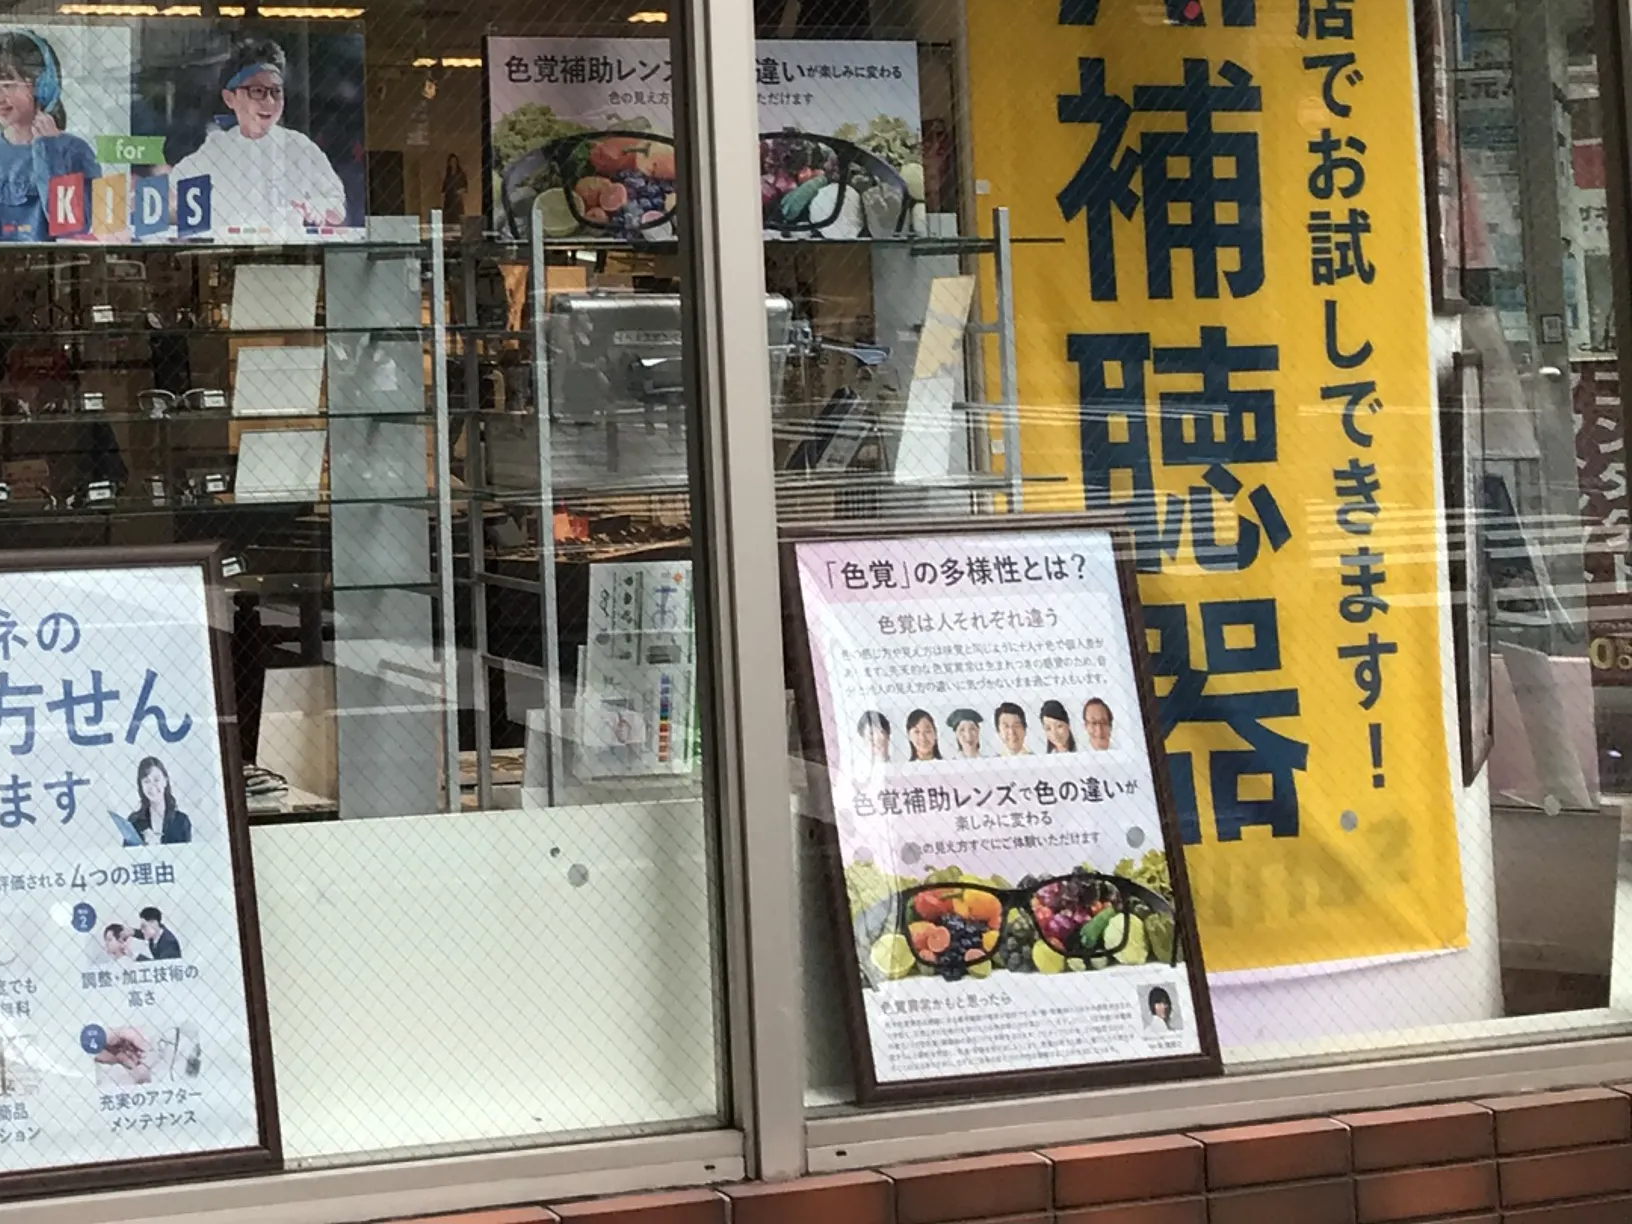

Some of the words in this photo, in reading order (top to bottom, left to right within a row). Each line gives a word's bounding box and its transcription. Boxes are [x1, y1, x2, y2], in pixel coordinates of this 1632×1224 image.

[114, 138, 146, 160] for
[55, 184, 204, 227] KIDS
[825, 553, 1087, 591] 「色覚」の多様性とは？
[877, 607, 1058, 636] 色覚は人それぞれ違う
[852, 778, 1139, 818] 色覚補助レンズで色の違いが
[954, 810, 1054, 832] 楽しみに変わる
[111, 1109, 198, 1133] メンテナンス
